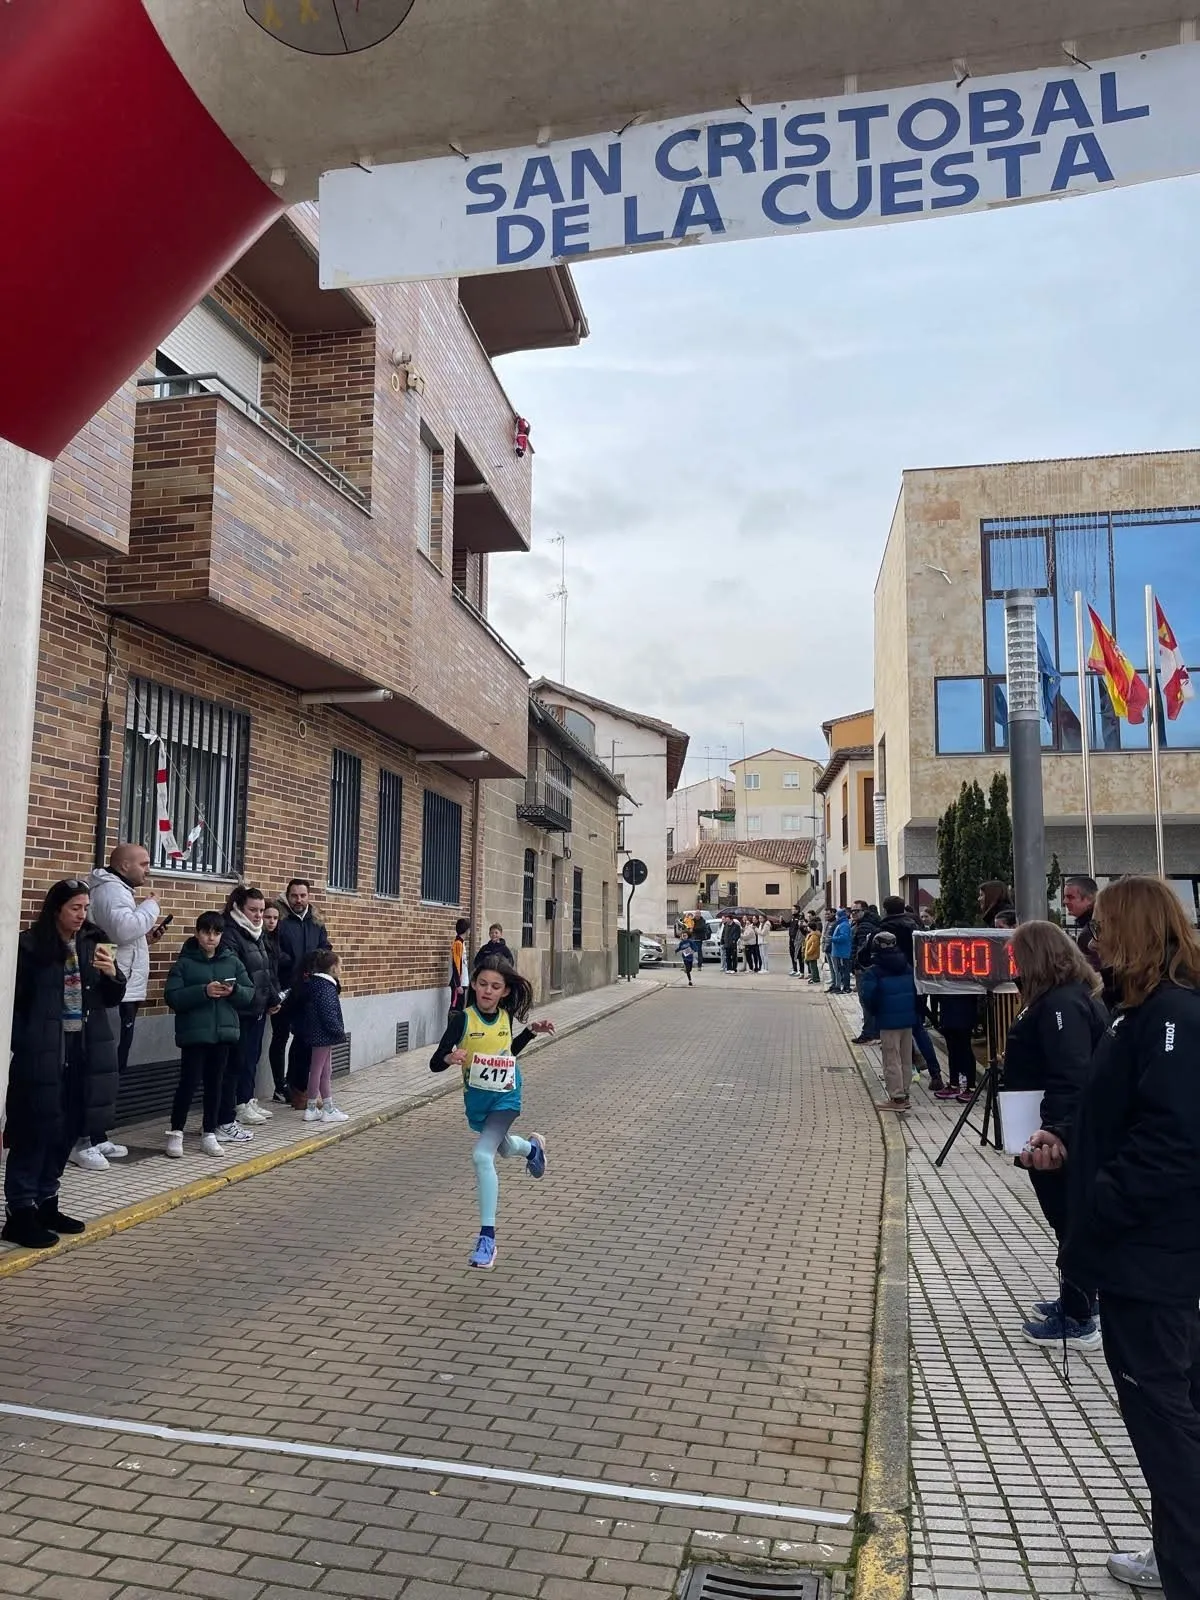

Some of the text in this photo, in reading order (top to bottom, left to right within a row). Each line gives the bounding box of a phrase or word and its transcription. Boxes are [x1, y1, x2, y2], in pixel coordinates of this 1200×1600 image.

[465, 71, 1150, 215] SAN CRISTOBAL
[496, 132, 1115, 265] DE LA CUESTA
[479, 1067, 508, 1083] 417
[1165, 1021, 1176, 1052] Joma
